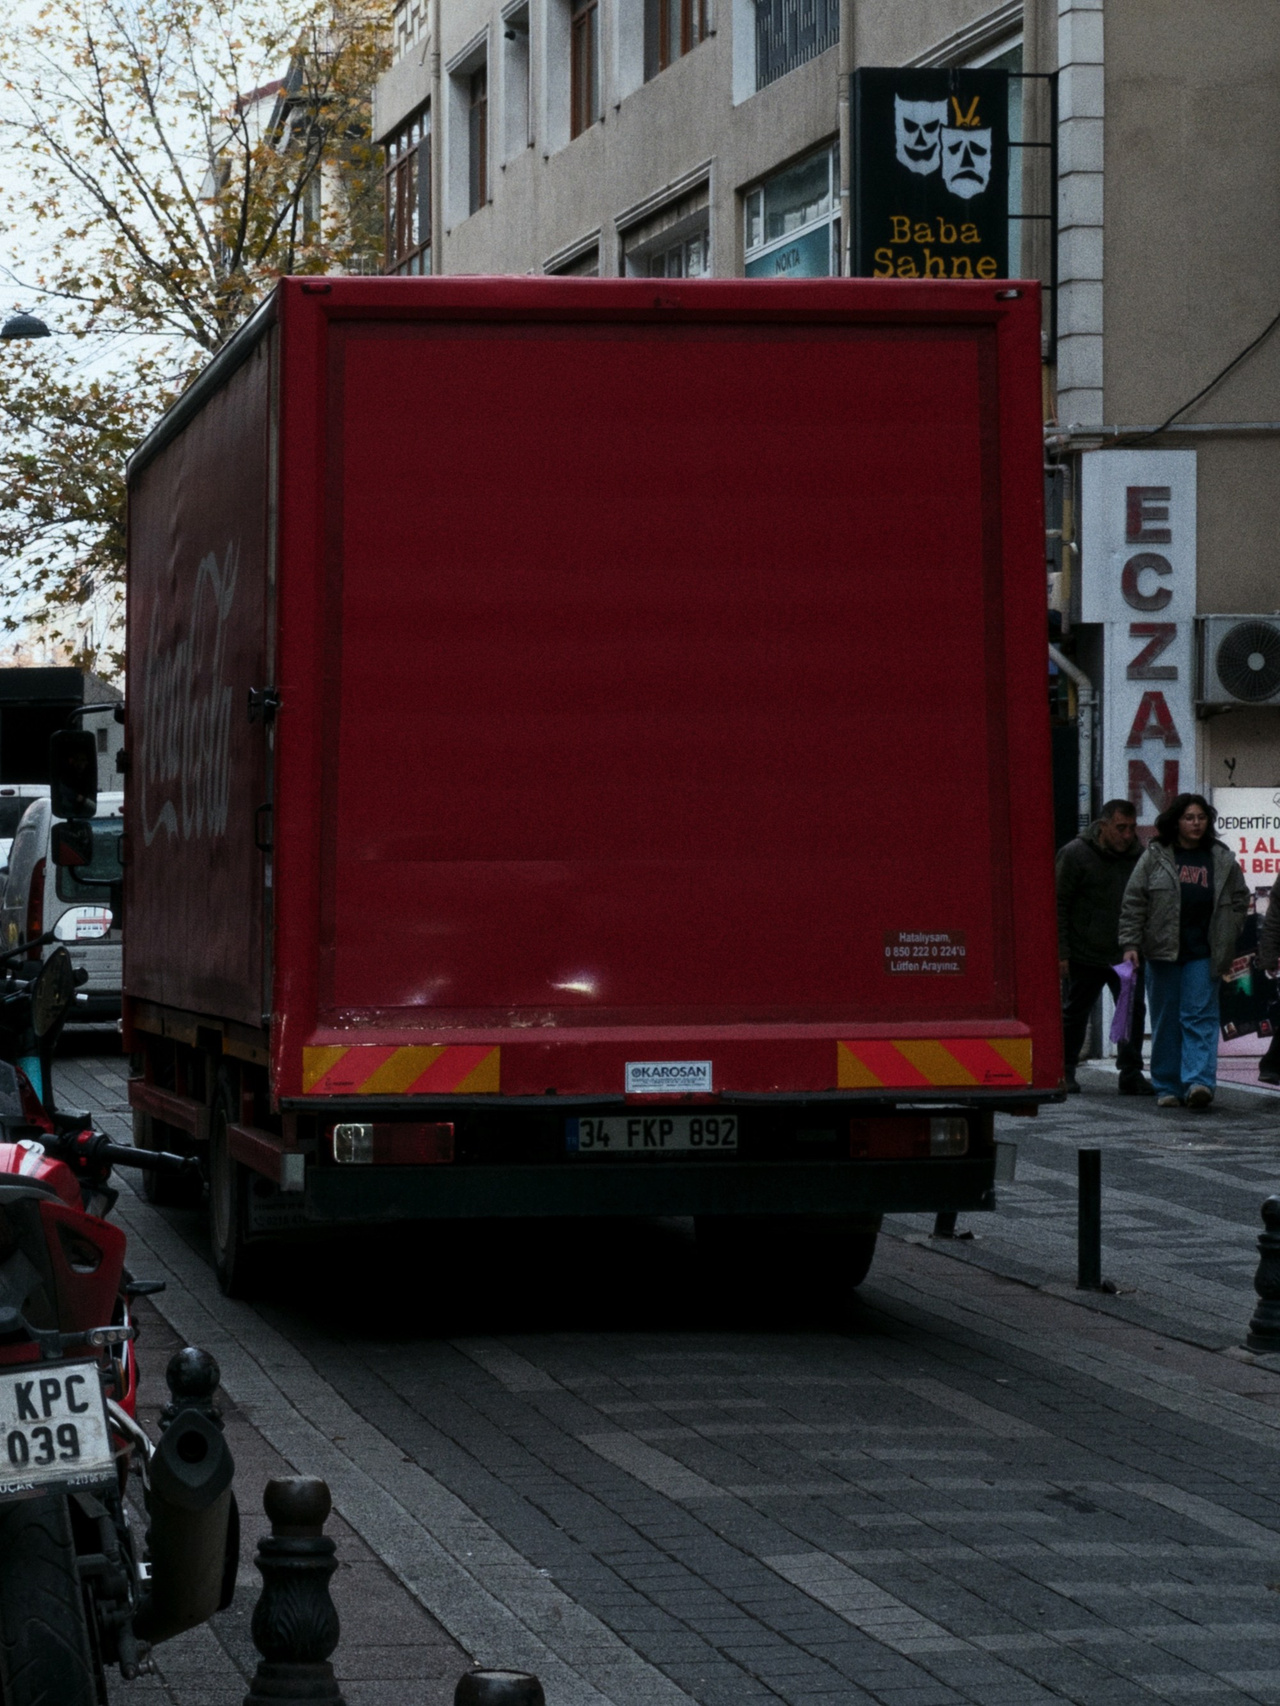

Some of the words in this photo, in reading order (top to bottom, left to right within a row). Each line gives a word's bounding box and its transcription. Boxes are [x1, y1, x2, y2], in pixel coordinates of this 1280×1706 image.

[889, 215, 981, 244] Baba
[775, 247, 800, 275] NOKTA
[873, 247, 998, 279] Sahne
[1218, 814, 1272, 830] DEDEKTİF
[1239, 837, 1248, 854] 1
[884, 946, 891, 957] 0
[893, 946, 911, 957] 850
[912, 946, 930, 957] 222
[931, 946, 938, 957] 0
[890, 960, 920, 972] Lütfen
[641, 1066, 707, 1078] KAROSAN
[580, 1120, 610, 1148] 34
[627, 1119, 674, 1147] FKP
[689, 1118, 736, 1146] 892
[14, 1374, 89, 1420] KPC
[7, 1423, 81, 1468] 039
